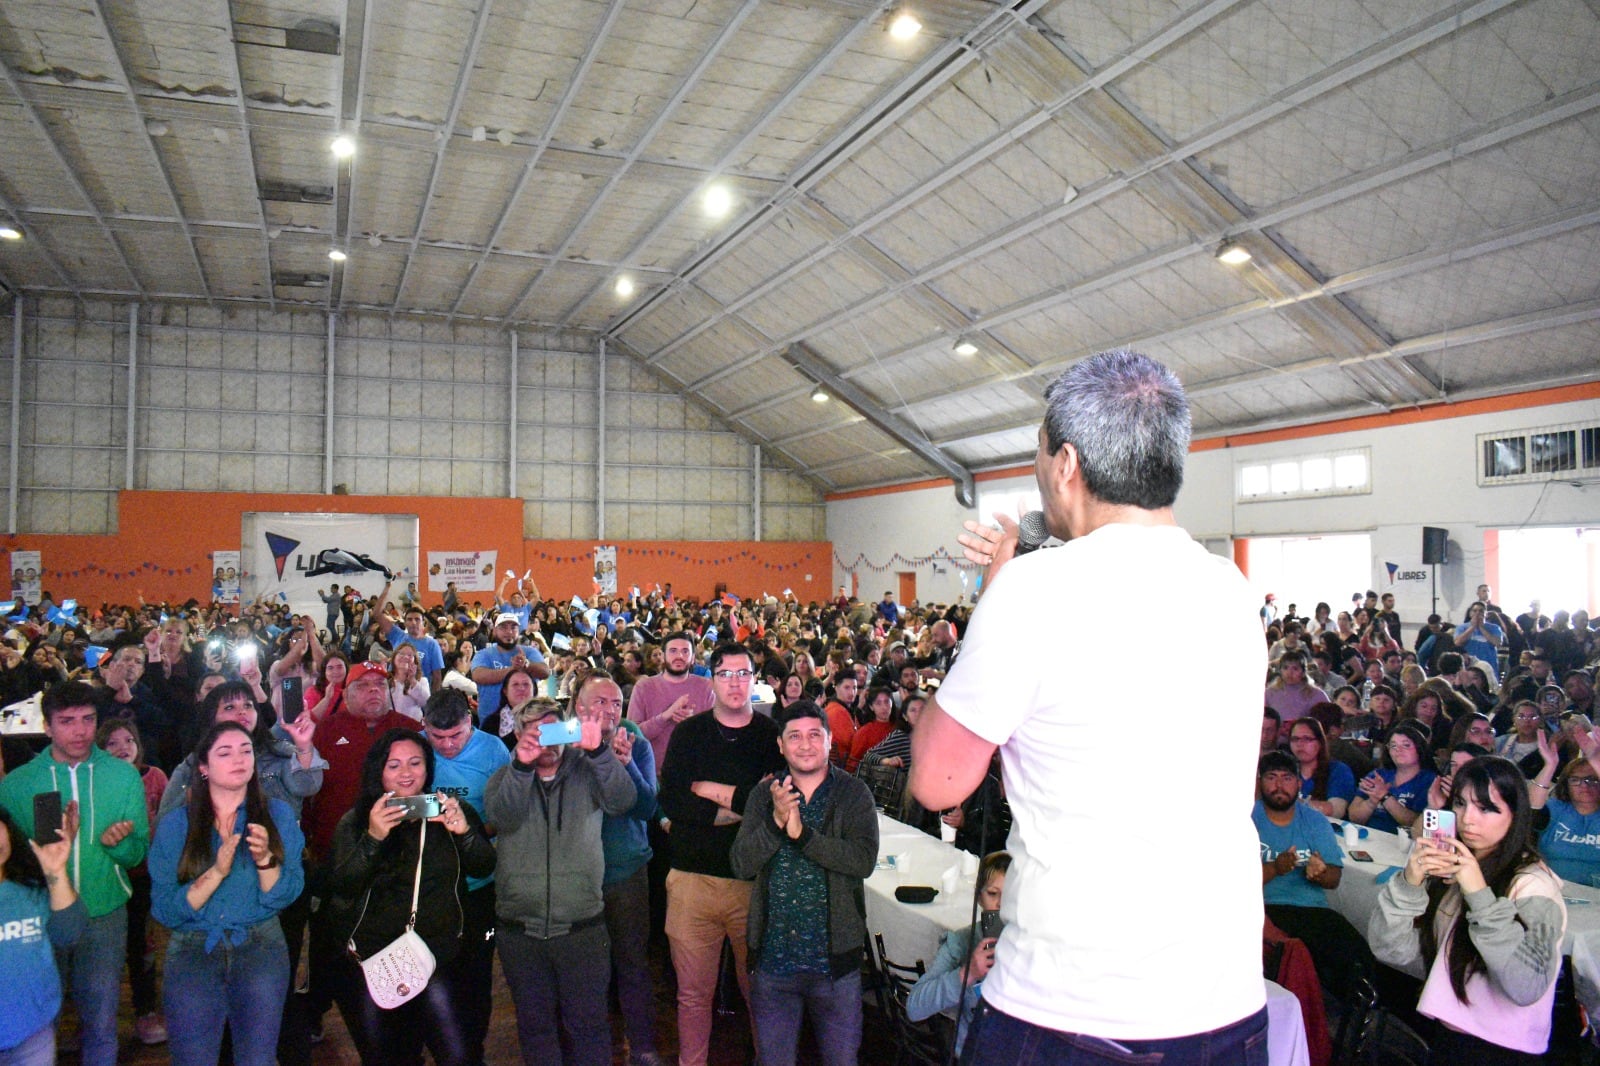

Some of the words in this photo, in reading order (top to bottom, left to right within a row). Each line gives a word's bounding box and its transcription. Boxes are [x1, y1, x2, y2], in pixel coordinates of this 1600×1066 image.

[1397, 570, 1427, 581] LIBRES
[1266, 848, 1312, 863] LIES
[0, 916, 42, 943] RE
